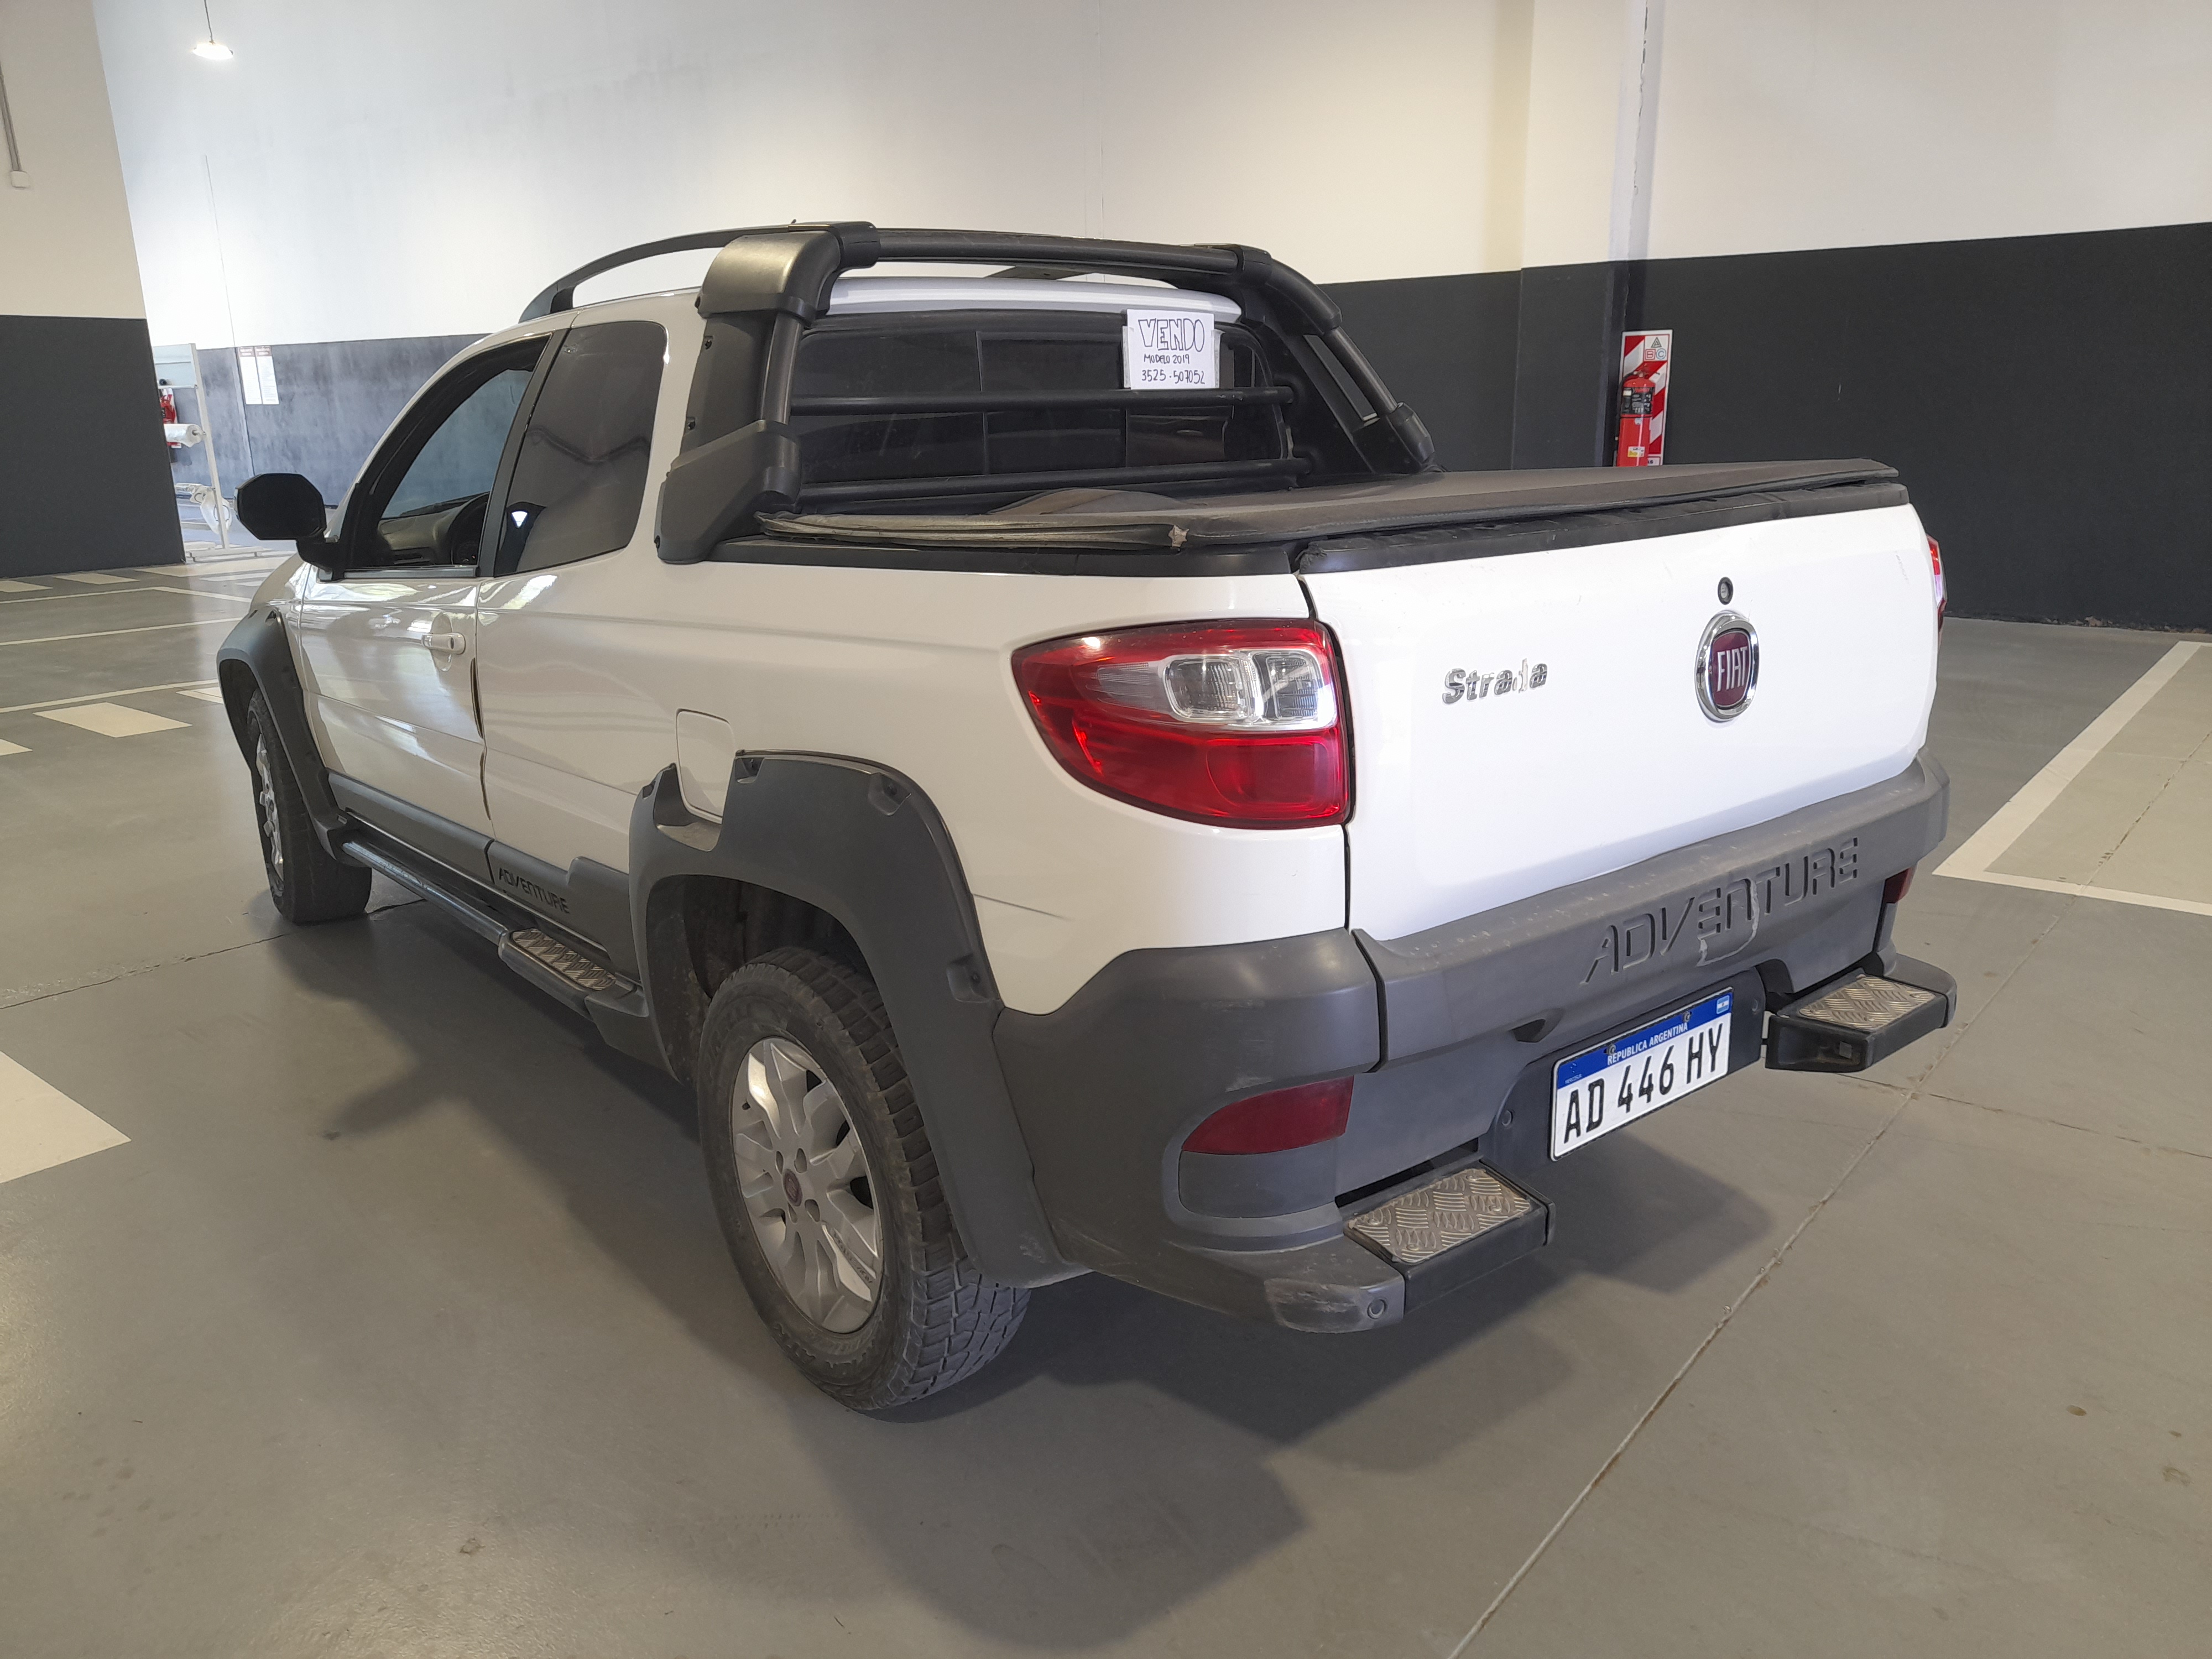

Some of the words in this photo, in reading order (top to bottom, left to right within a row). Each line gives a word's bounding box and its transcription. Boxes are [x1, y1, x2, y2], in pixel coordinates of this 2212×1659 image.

[1138, 317, 1205, 352] VENDO
[1646, 350, 1654, 358] B
[1144, 353, 1170, 364] MODELO
[1172, 353, 1190, 364] 2019
[1717, 646, 1748, 692] FIAT
[498, 867, 570, 914] ADVENTURE
[1580, 837, 1859, 984] ADVENTURE
[1607, 1040, 1647, 1066] REPUBLICA
[1649, 1022, 1688, 1047] ARGENTINA
[1563, 1077, 1605, 1144] AD
[1617, 1045, 1674, 1114] 446
[1686, 1022, 1724, 1084] HY
